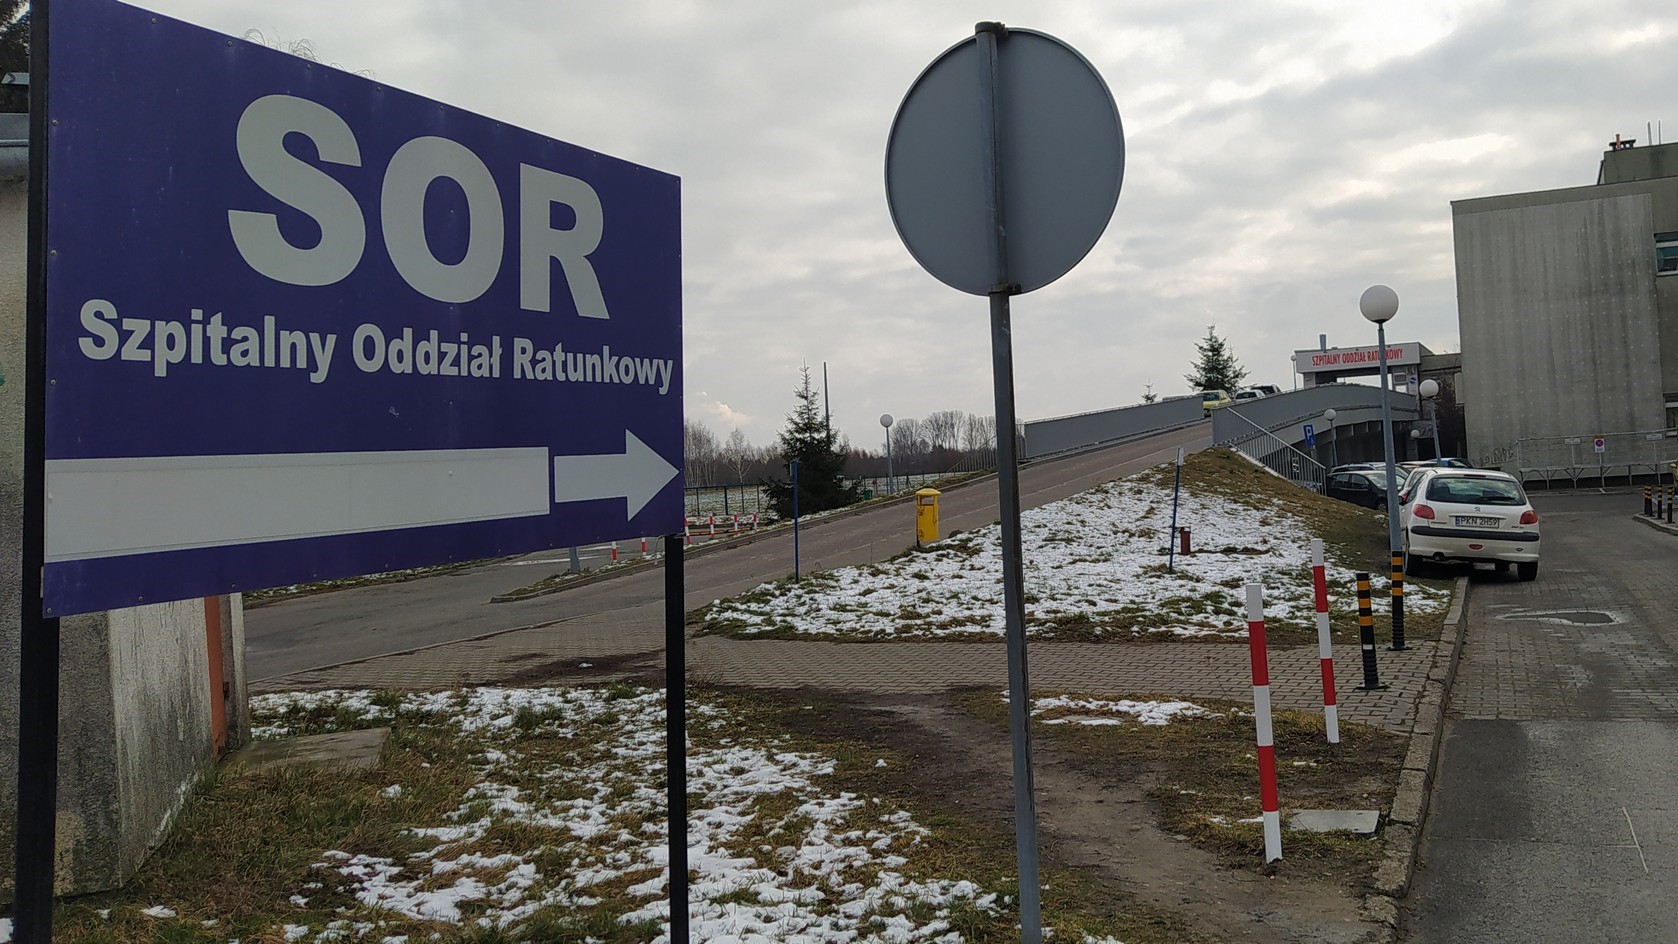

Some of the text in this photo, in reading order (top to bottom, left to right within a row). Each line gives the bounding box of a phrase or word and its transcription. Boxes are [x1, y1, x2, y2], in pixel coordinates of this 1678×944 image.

[227, 94, 610, 319] SOR
[78, 299, 674, 395] Szpitalny Oddział Ratunkowy
[1312, 348, 1403, 366] SZPITALNY ODDZIAŁ RATUKOWY
[1460, 516, 1478, 525] PKN
